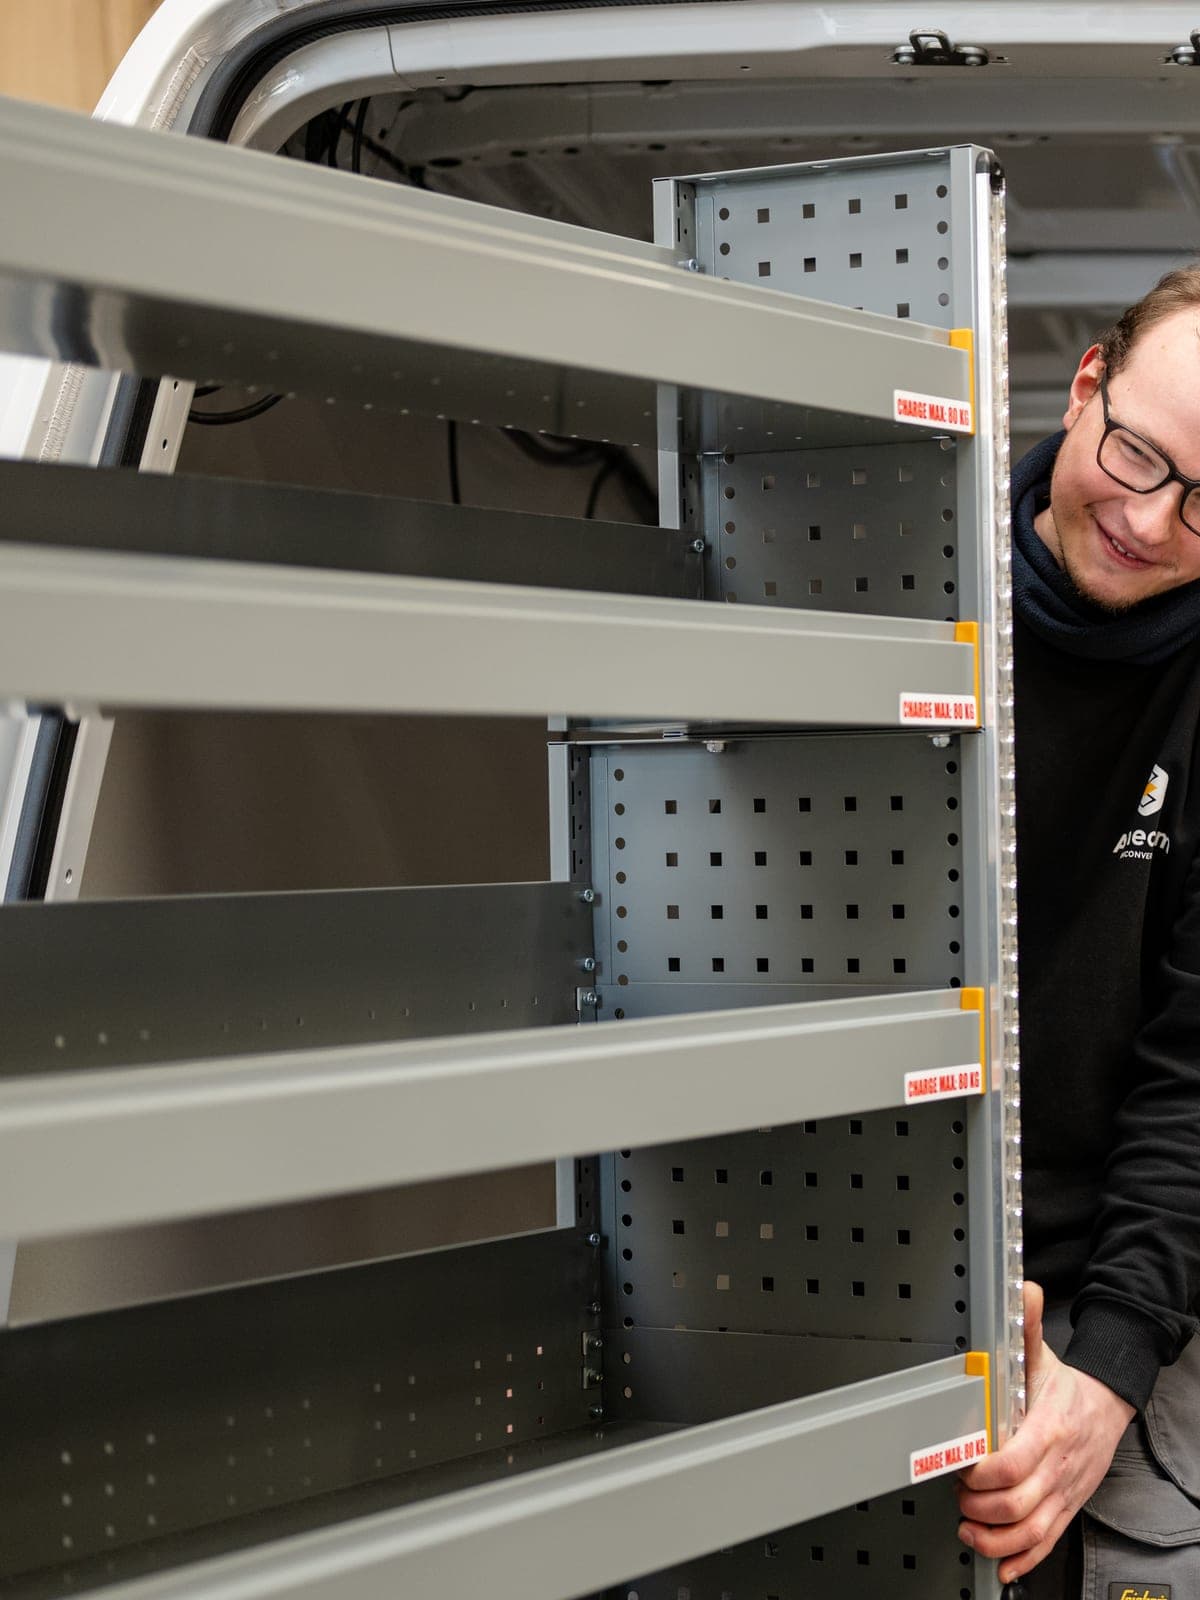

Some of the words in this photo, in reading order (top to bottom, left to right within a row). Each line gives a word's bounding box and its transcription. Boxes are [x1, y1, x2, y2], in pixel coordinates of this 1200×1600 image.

[898, 398, 927, 419] CHARGE
[949, 406, 958, 425] 80
[960, 408, 969, 426] KG
[903, 700, 932, 719] CHARGE
[954, 702, 963, 719] 80
[965, 703, 974, 720] KG
[908, 1077, 937, 1097] CHARGE
[959, 1072, 968, 1090] 80
[970, 1071, 979, 1088] KG
[914, 1451, 943, 1477] CHARGE
[965, 1441, 974, 1460] 80
[976, 1438, 985, 1456] KG
